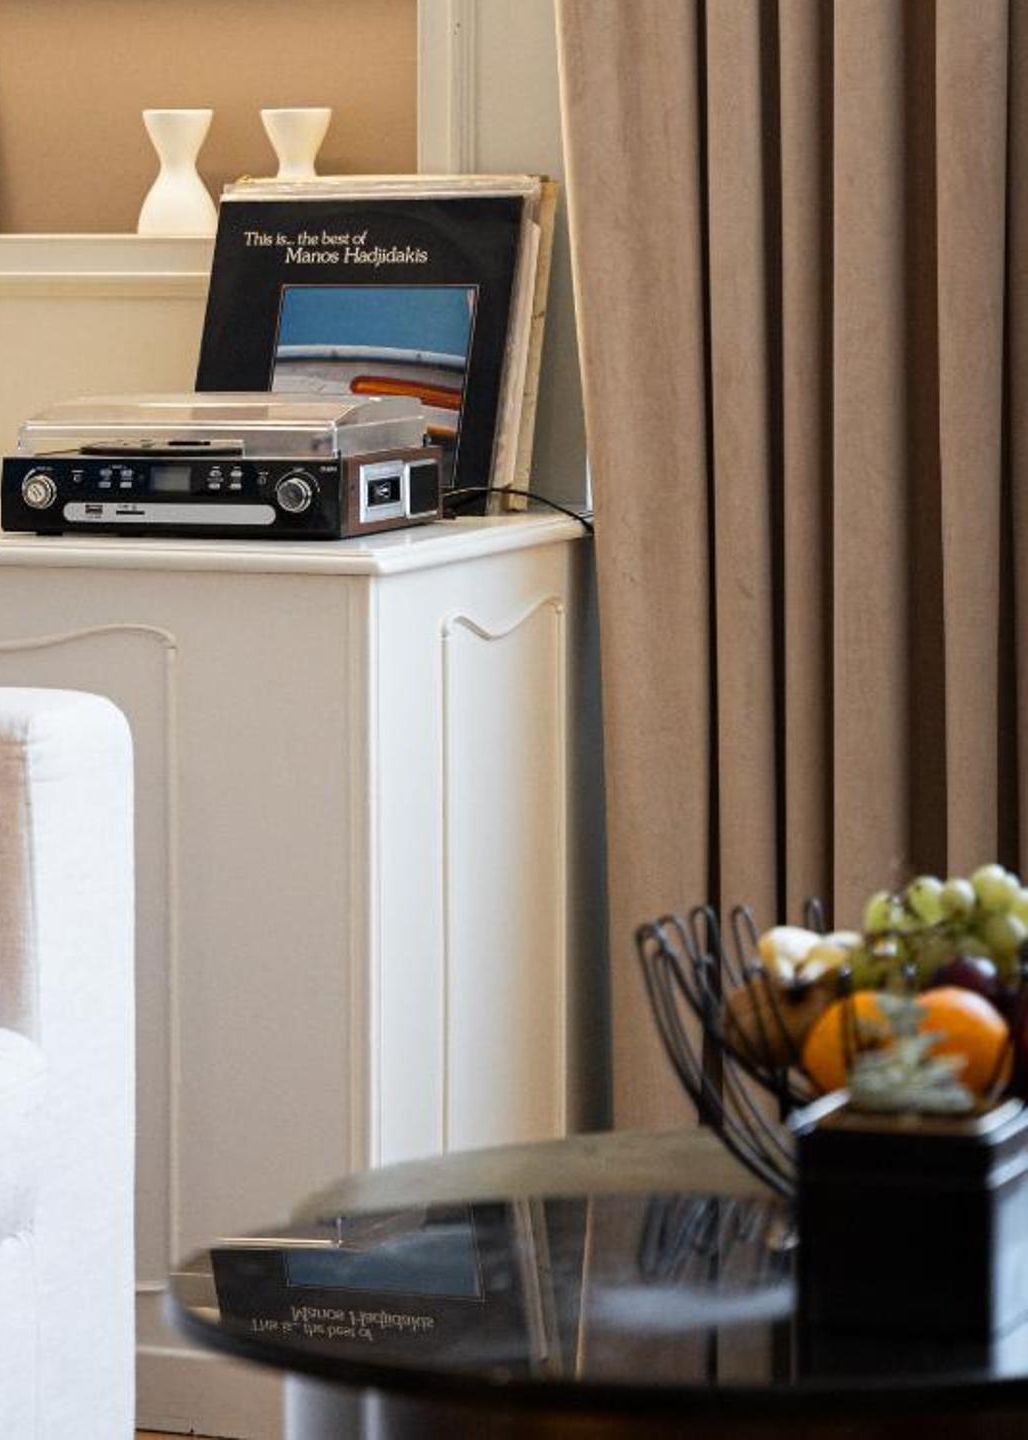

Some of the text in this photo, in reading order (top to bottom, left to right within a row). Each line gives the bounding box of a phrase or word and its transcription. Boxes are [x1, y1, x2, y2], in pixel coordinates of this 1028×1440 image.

[244, 231, 273, 247] This
[297, 230, 319, 246] the
[321, 229, 350, 245] best
[351, 230, 369, 245] of
[284, 246, 429, 268] Manos Hadjidakis
